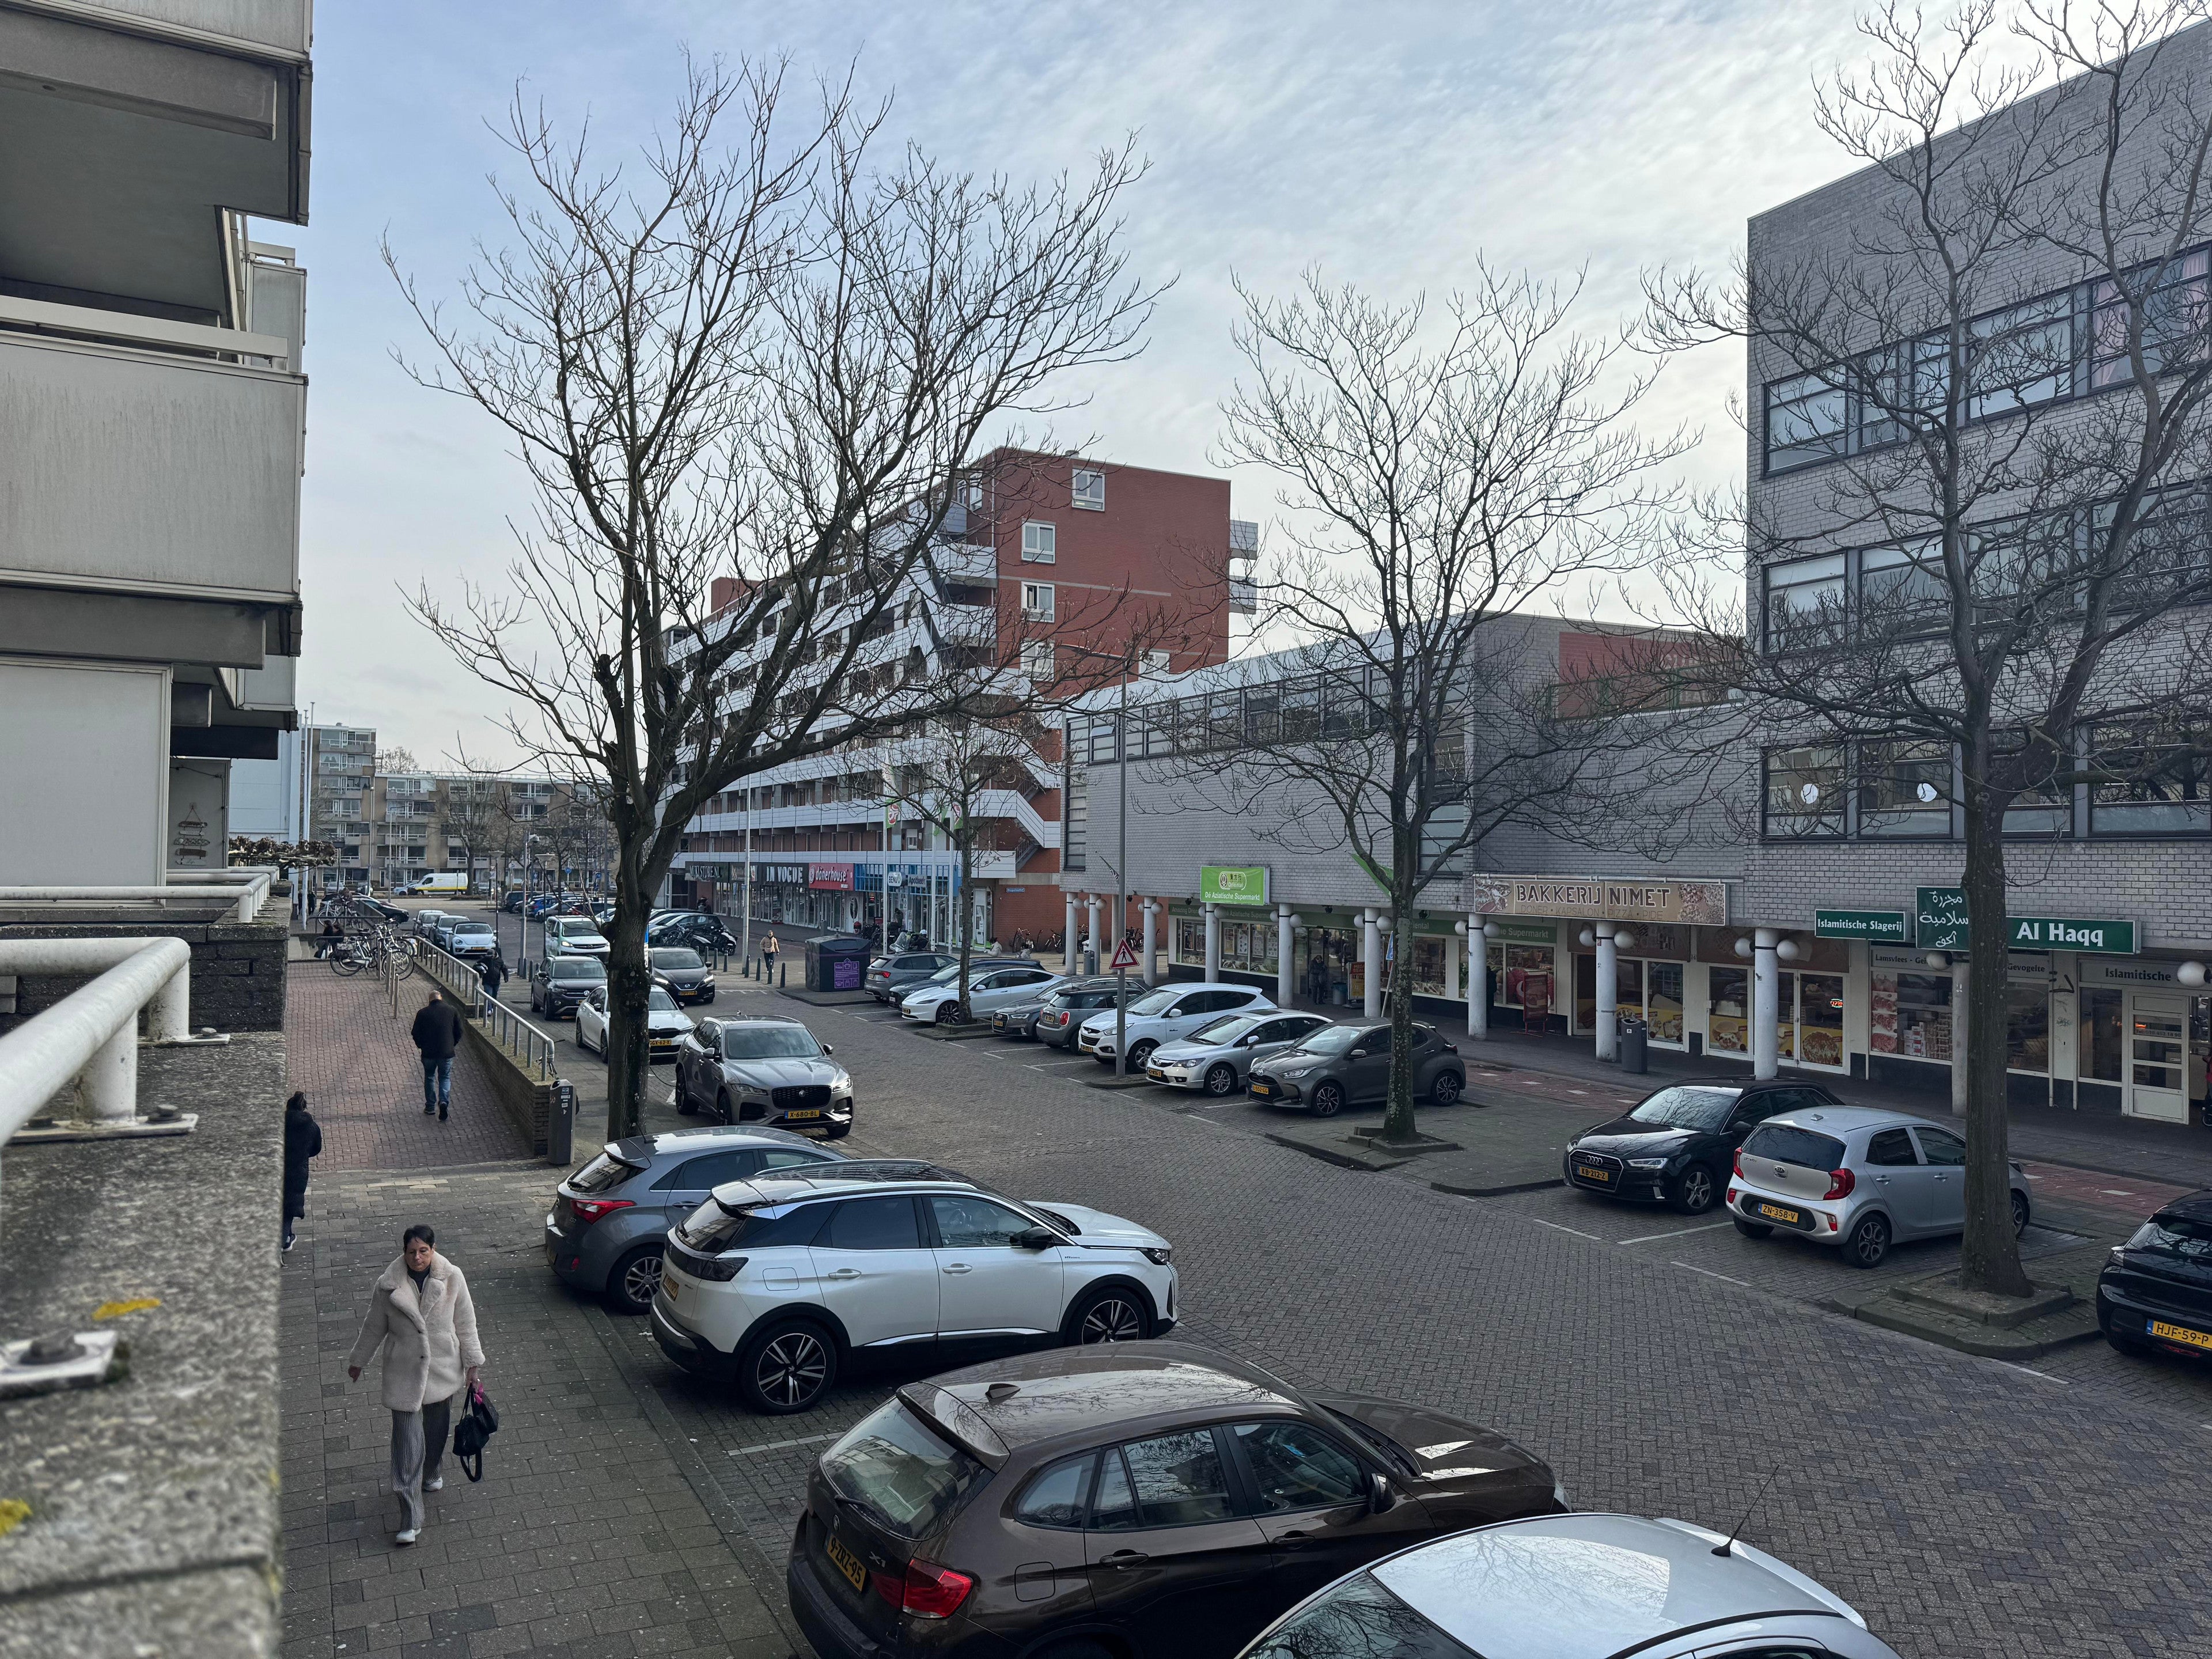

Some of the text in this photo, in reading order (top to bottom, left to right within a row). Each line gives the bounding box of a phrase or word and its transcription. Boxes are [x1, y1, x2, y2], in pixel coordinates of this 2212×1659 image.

[767, 866, 803, 883] IN VOGUE
[816, 866, 846, 881] dönerhouse
[1515, 884, 1671, 908] BAKKERIJ NIMET
[1556, 908, 1600, 916] KAPSALON
[1608, 909, 1633, 918] PIZZA
[1643, 910, 1663, 919] PIDE
[1508, 928, 1548, 938] Supermarkt
[1817, 918, 1902, 933] Islamitische Slagerij
[2016, 922, 2103, 947] Al Haqq
[1876, 954, 1907, 963] Lamsvlees
[2008, 963, 2045, 973] Gevogelte
[2105, 968, 2171, 981] Islamitische
[1581, 1168, 1606, 1179] KB-212-Z
[1763, 1205, 1796, 1220] ZN-358-V
[2156, 1324, 2209, 1344] HJF-59-P
[830, 1536, 863, 1585] 9-ZRZ-95
[869, 1551, 886, 1568] X1
